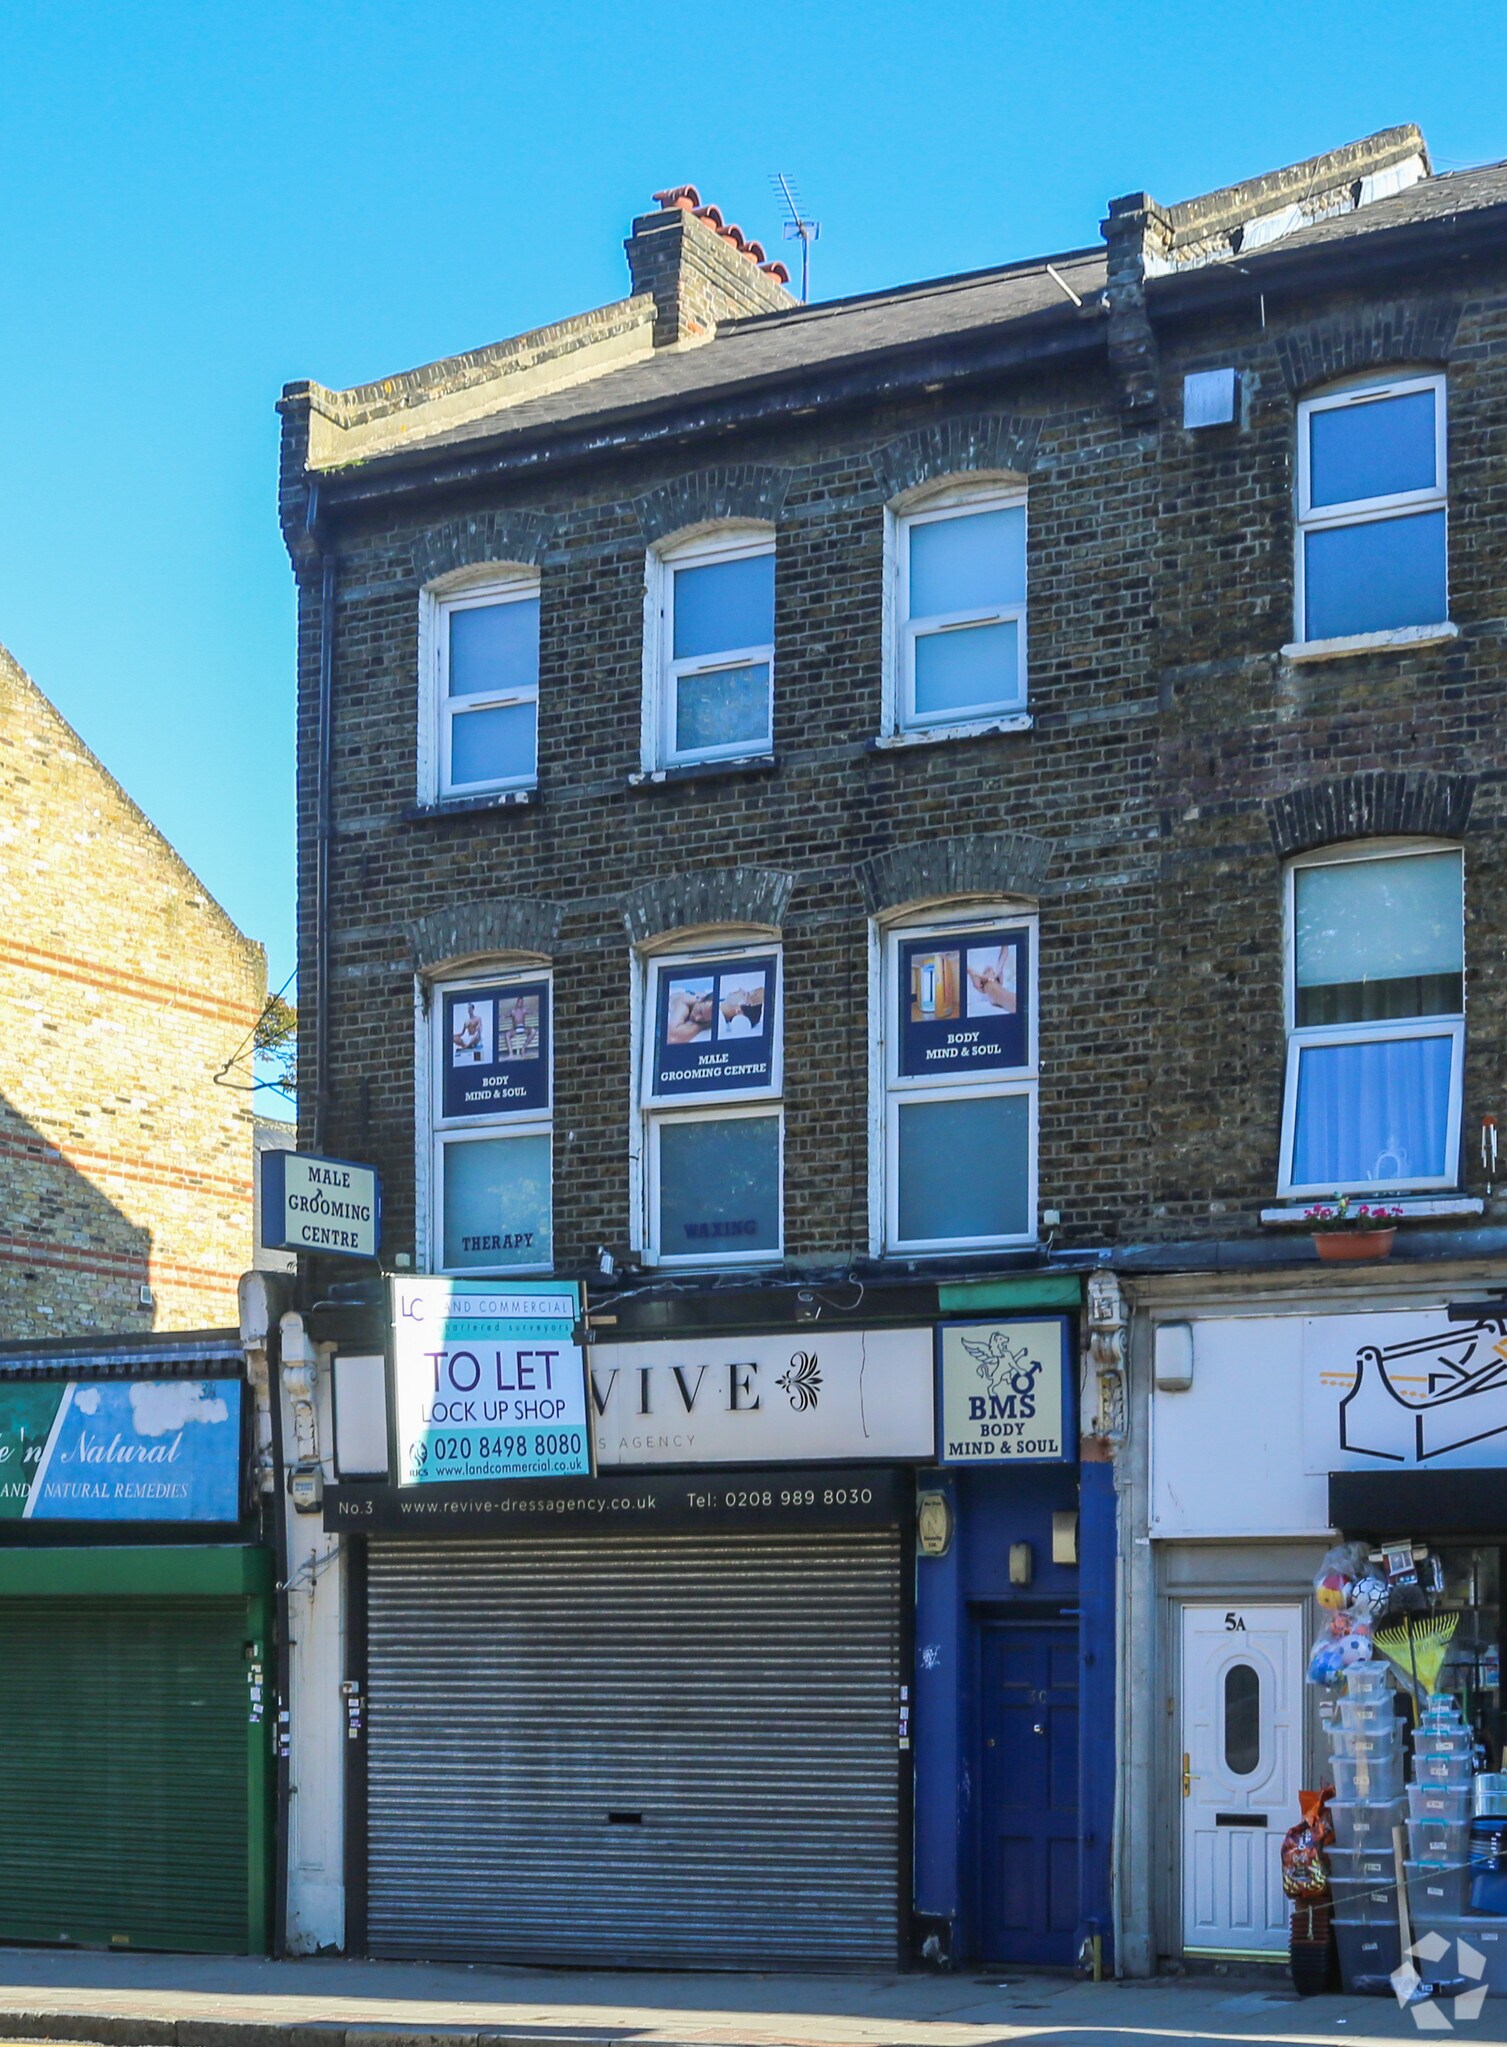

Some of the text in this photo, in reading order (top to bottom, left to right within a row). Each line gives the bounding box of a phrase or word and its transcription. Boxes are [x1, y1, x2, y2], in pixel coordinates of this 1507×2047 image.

[947, 1032, 980, 1044] BODY
[698, 1053, 729, 1065] MALE
[925, 1044, 1002, 1060] MIND & SOUL
[482, 1076, 509, 1087] BODY
[660, 1063, 767, 1082] GROOMING CENTRE
[465, 1087, 527, 1101] MIND & SOUL
[308, 1166, 351, 1188] MALE
[288, 1193, 371, 1222] GROOMING
[302, 1225, 359, 1248] CENTRE
[461, 1232, 534, 1251] THERAPY
[479, 1301, 568, 1313] COMMERCIAL
[440, 1321, 570, 1334] hartered surveyors
[424, 1351, 560, 1392] TO LET
[421, 1399, 566, 1424] LOCK UP SHOP
[968, 1394, 1036, 1421] BMS
[980, 1422, 1026, 1437] BODY
[61, 1430, 184, 1464] Natural
[434, 1433, 581, 1460] 020 8498 8080
[618, 1434, 696, 1449] AGENCY
[949, 1439, 1058, 1456] MIND & SOUL
[435, 1457, 583, 1477] www.landcommercial.co.uk
[1, 1482, 189, 1498] AND NATURAL REMEDIES
[687, 1488, 873, 1508] Tel: 0208 989 8030
[338, 1500, 374, 1515] No.3
[400, 1494, 658, 1515] www.revive-dressagency.co.uk
[1224, 1612, 1247, 1631] 5A
